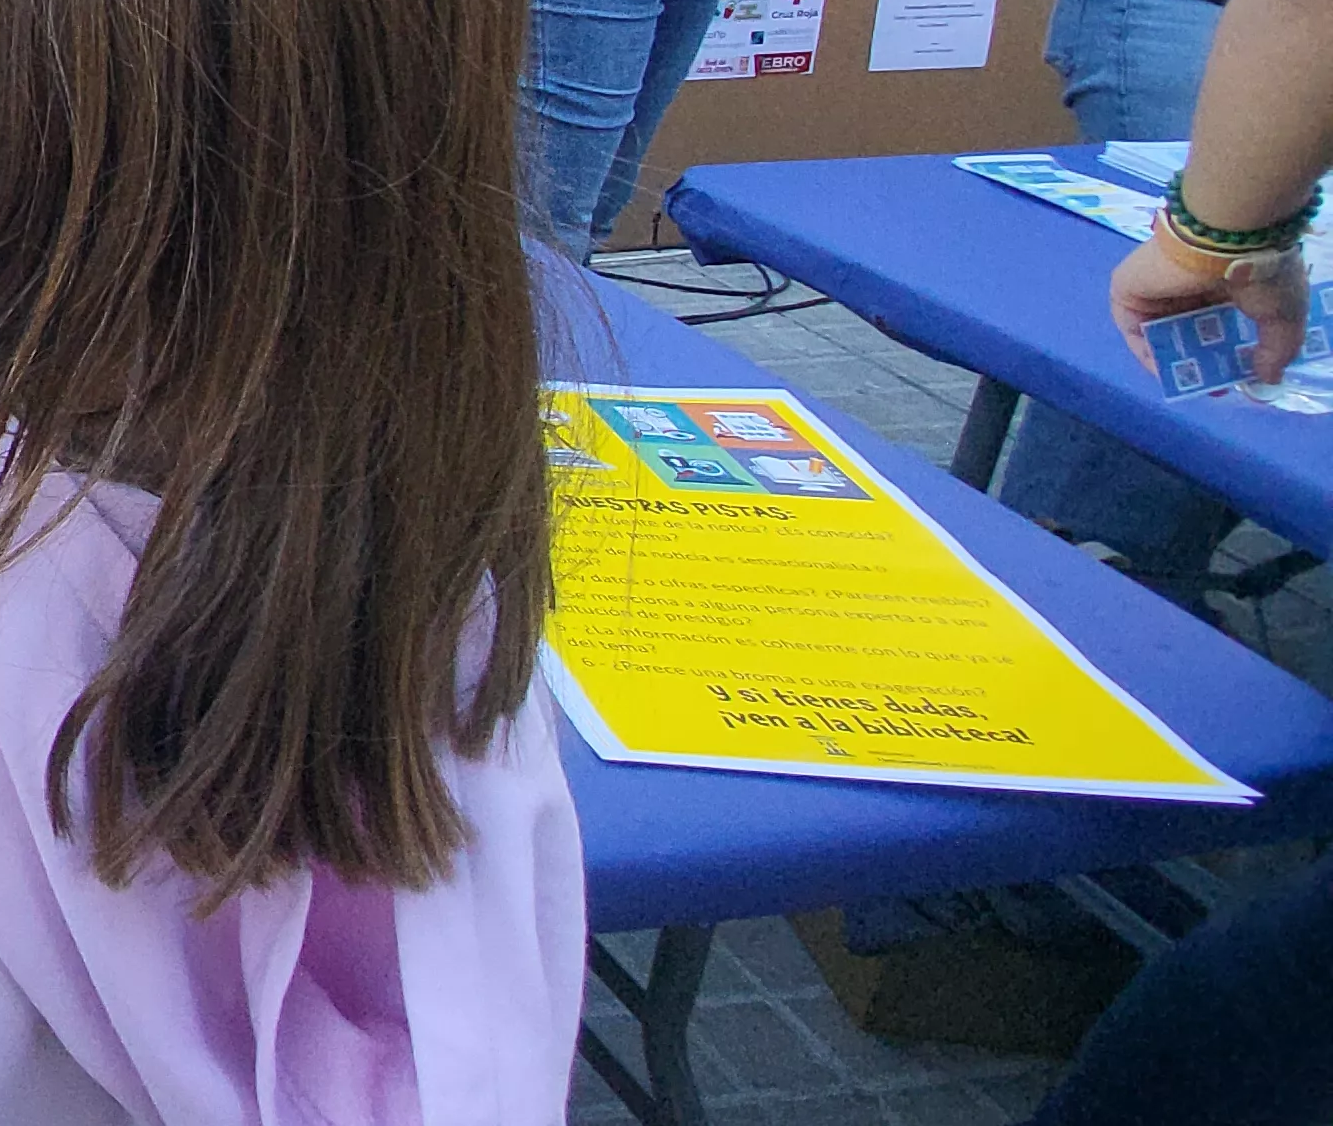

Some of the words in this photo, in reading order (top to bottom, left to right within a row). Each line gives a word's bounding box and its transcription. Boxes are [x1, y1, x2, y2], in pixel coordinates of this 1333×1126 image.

[762, 55, 806, 69] EBRO
[690, 502, 800, 522] PISTAS:
[706, 683, 733, 703] y
[736, 687, 770, 705] si
[771, 688, 879, 712] tienes
[882, 694, 989, 721] dudas,
[718, 709, 789, 730] ¡ven
[795, 715, 818, 731] a
[815, 711, 855, 733] la
[851, 715, 1036, 746] biblioteca!
